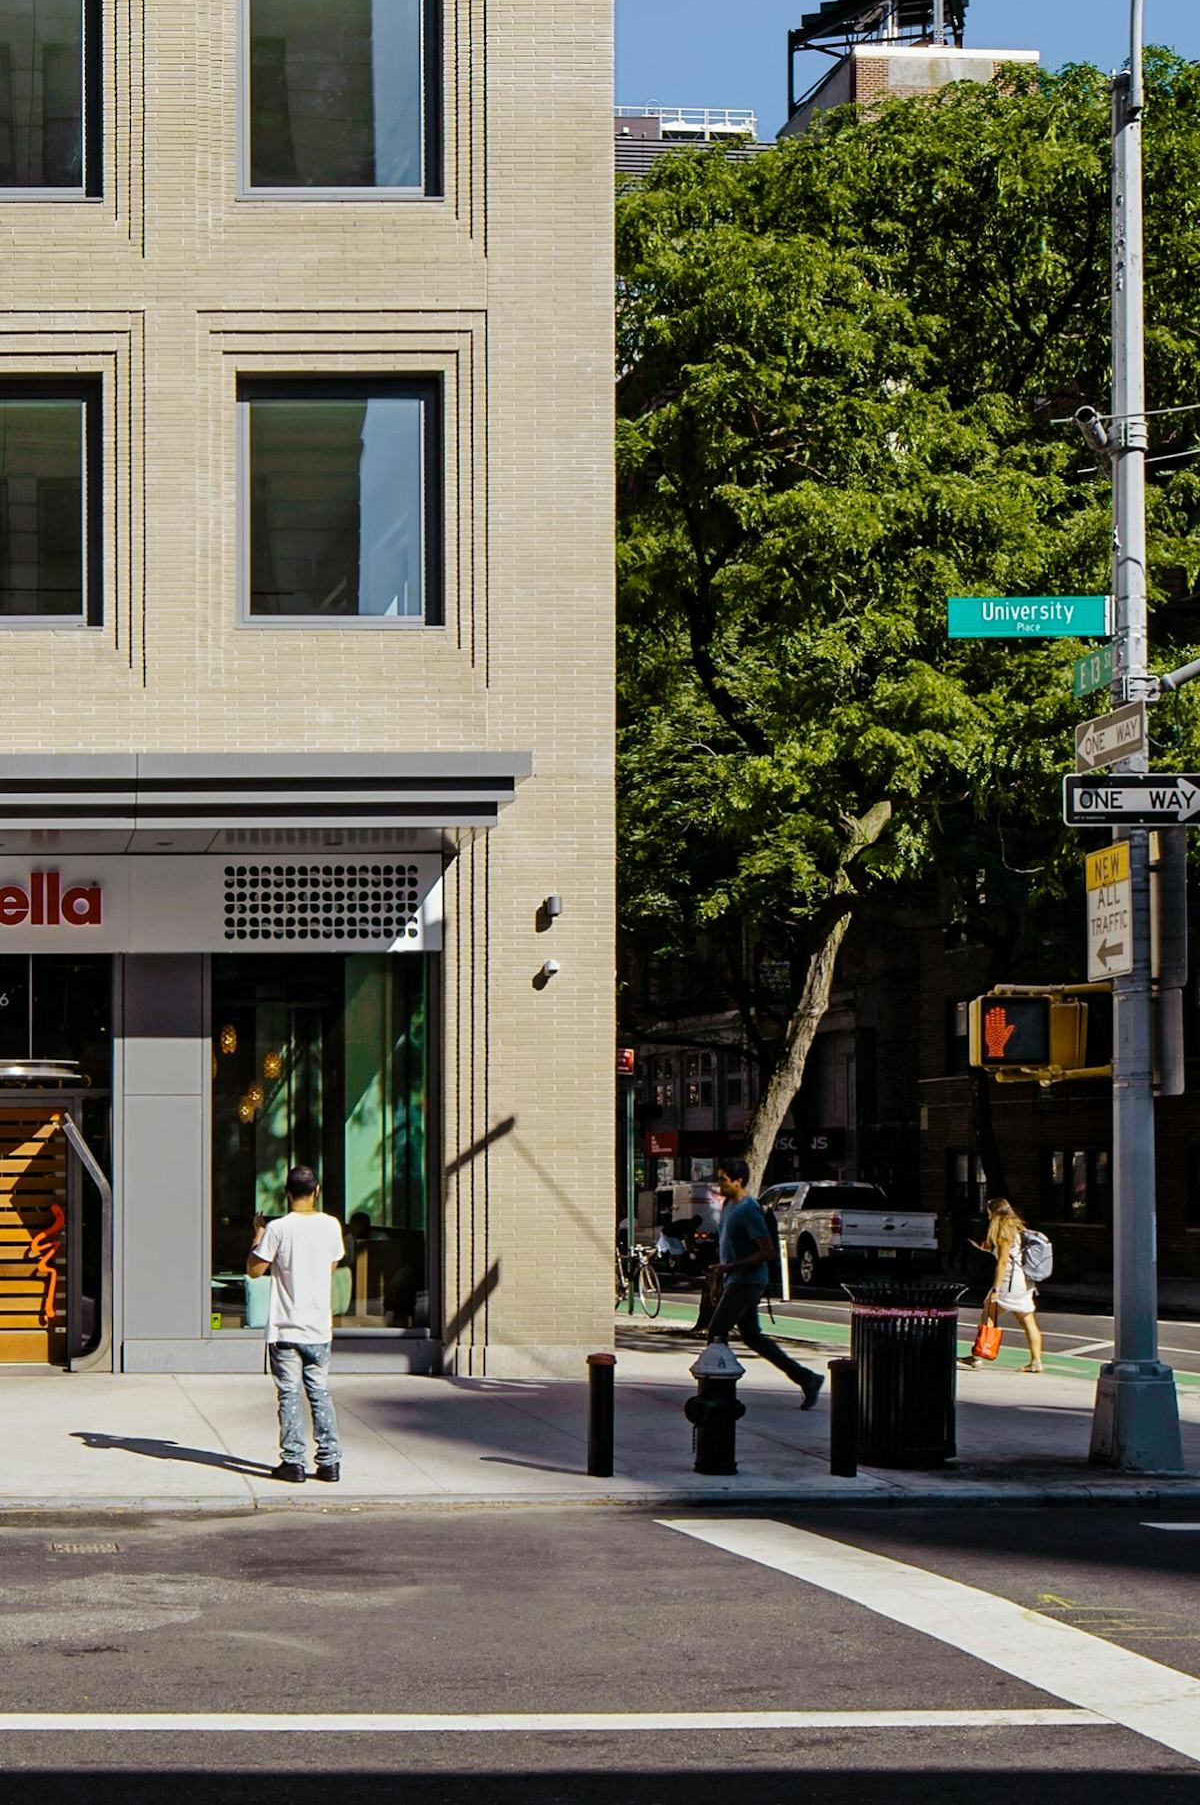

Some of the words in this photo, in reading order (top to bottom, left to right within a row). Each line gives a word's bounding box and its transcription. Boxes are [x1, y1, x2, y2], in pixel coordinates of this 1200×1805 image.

[982, 601, 1074, 624] University
[1016, 622, 1041, 632] Place
[1080, 663, 1087, 690] E
[1090, 656, 1101, 685] 13
[1084, 732, 1106, 756] ONE
[1115, 718, 1138, 745] WAY
[1079, 790, 1124, 810] ONE
[1148, 790, 1197, 810] WAY
[1094, 851, 1120, 883] NEW
[1097, 884, 1121, 910] ALL
[1091, 909, 1128, 937] TRAFFIC
